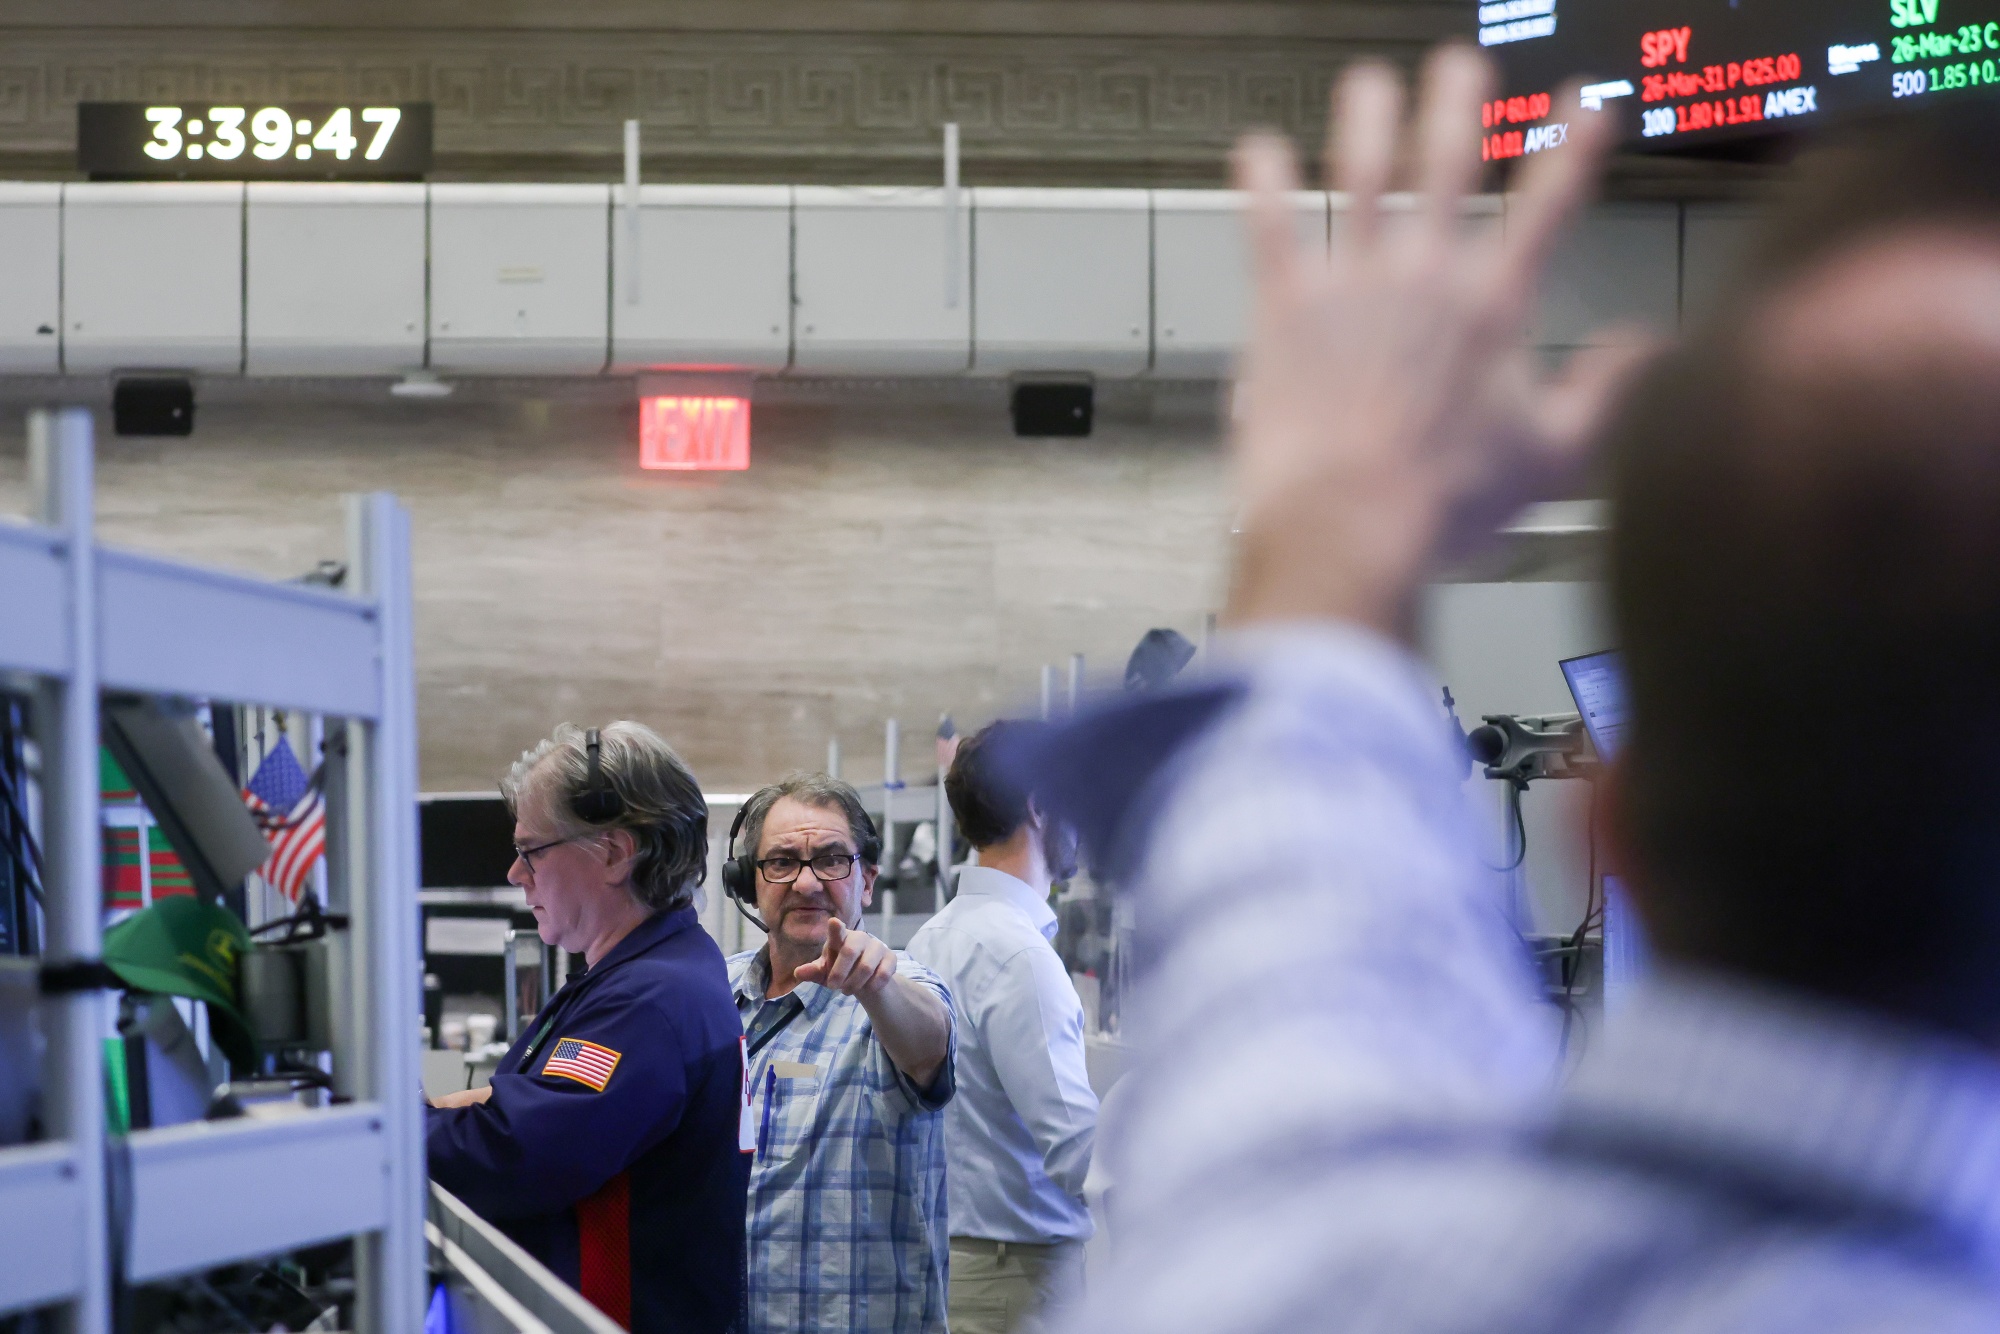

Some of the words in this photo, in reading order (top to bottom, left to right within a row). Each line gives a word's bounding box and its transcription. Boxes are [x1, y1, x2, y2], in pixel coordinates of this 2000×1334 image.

[1889, 0, 1939, 28] SLV
[1641, 26, 1692, 68] SPY
[1727, 62, 1741, 89] P
[1742, 52, 1802, 87] 625.00
[1892, 69, 1927, 98] 500
[1642, 106, 1677, 137] 100
[1763, 85, 1818, 120] AMEX
[143, 107, 401, 160] 3:39:47
[1524, 122, 1569, 155] AMEX
